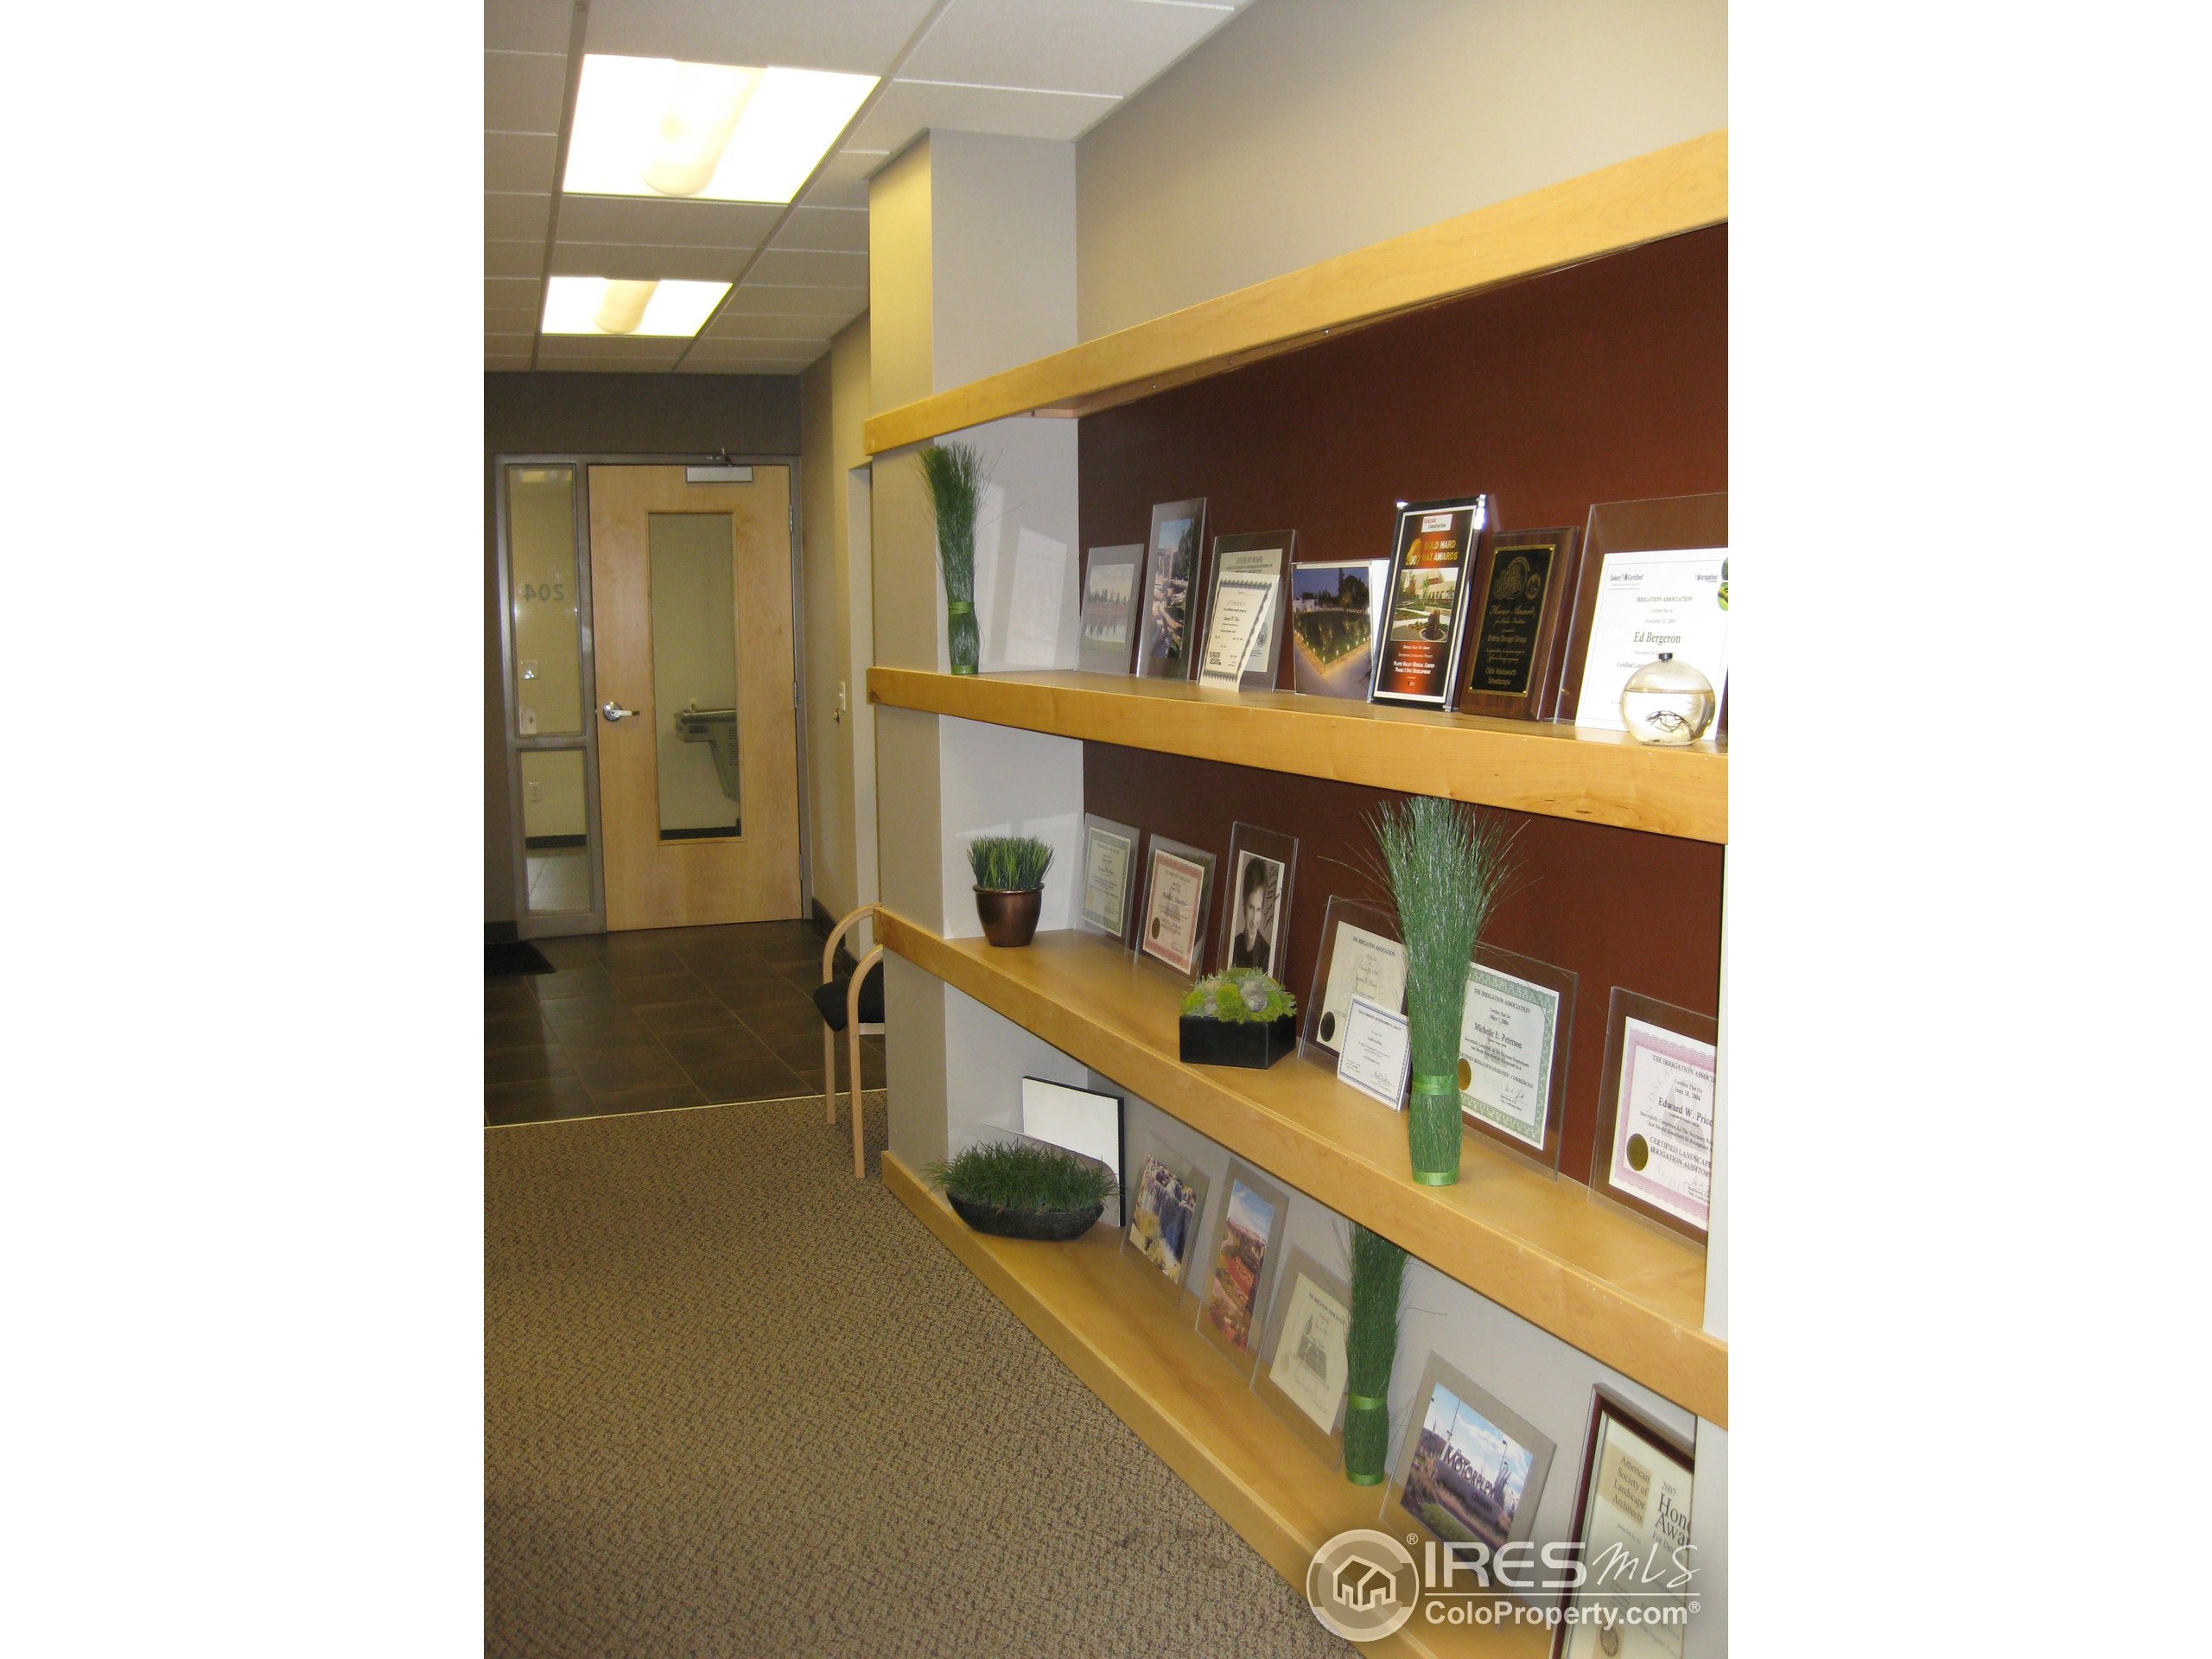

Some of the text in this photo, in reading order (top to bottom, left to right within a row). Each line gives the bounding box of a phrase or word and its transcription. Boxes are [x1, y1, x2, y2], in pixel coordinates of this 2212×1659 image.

[1424, 540, 1456, 550] GOLD HARD
[1433, 551, 1459, 562] AWARDS
[1633, 632, 1681, 645] Ed Bergeron
[1481, 990, 1504, 1003] IRRIGATION
[1504, 1000, 1531, 1014] ASSOCIATION
[1474, 1022, 1495, 1038] Michelle
[1495, 1031, 1501, 1040] L.
[1501, 1033, 1522, 1049] Peterson
[1652, 1055, 1662, 1065] THE
[1662, 1058, 1694, 1076] IRRIGATION
[1675, 1086, 1684, 1095] June
[1658, 1096, 1684, 1115] Edward
[1685, 1107, 1695, 1120] W.
[1696, 1112, 1713, 1127] Price
[1649, 1136, 1713, 1169] CERTIFIED LANDSCAPE
[1650, 1146, 1710, 1178] IRRIGATION AUDITOR
[1443, 1444, 1495, 1500] MOTORPLEX
[1617, 1466, 1649, 1497] Society of
[1620, 1455, 1650, 1484] American
[1613, 1478, 1646, 1510] Landscape
[1661, 1480, 1676, 1497] 2007
[1612, 1493, 1643, 1523] Architects
[1652, 1530, 1663, 1545] For
